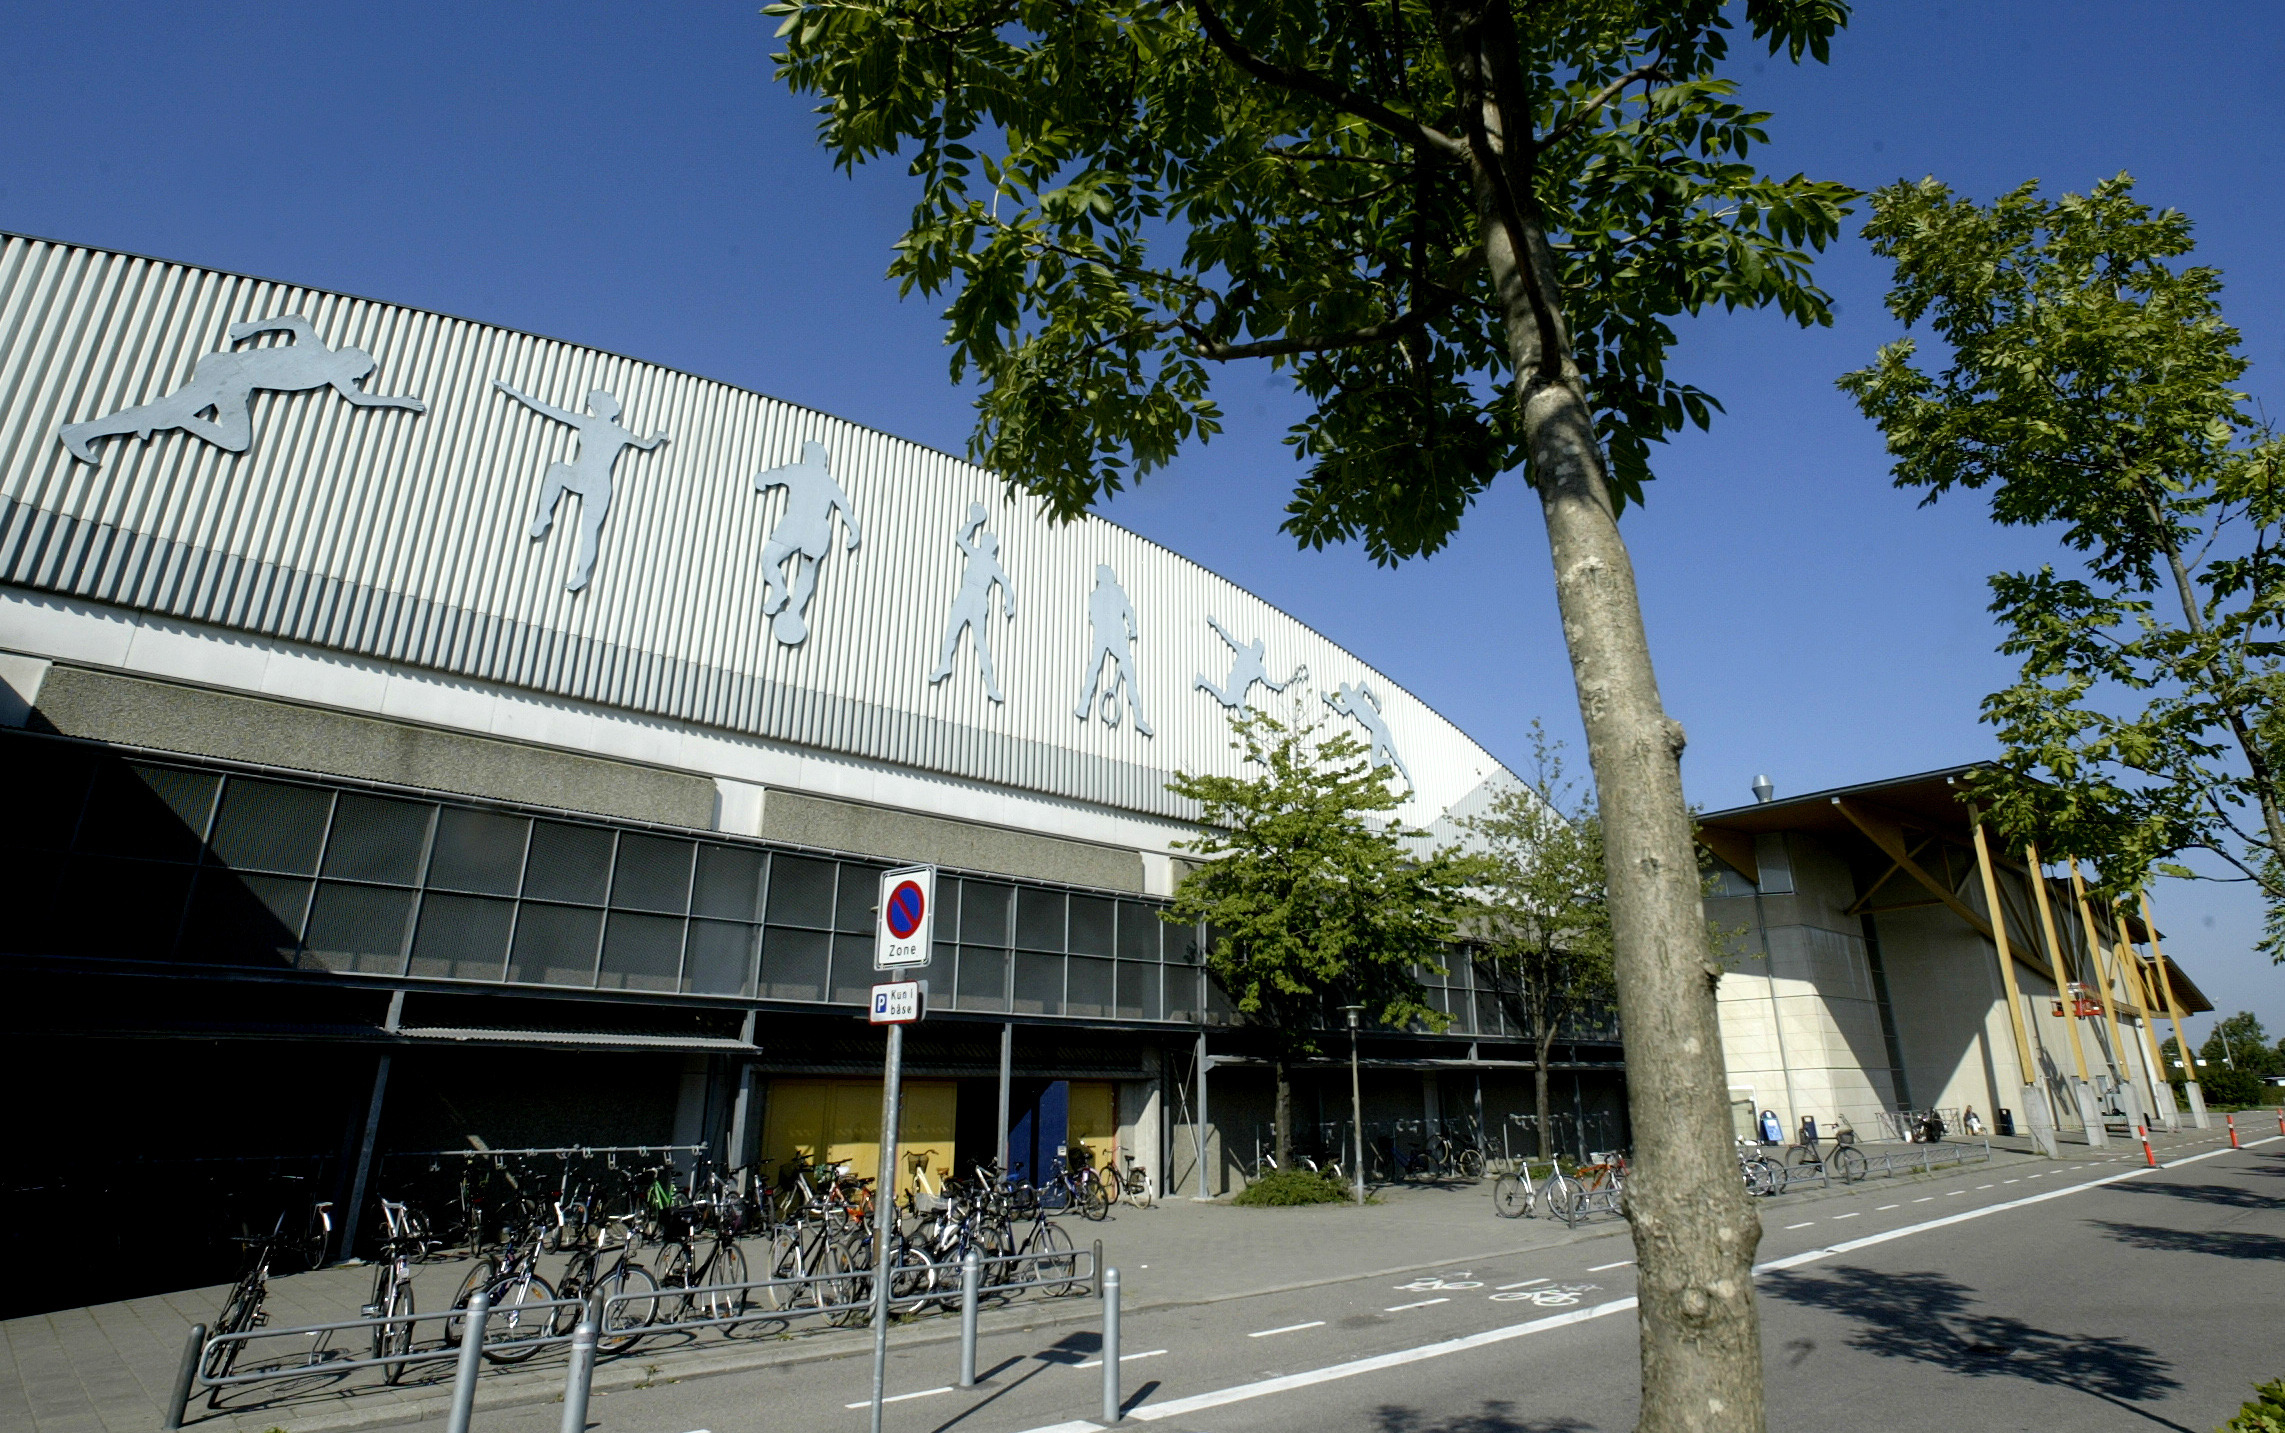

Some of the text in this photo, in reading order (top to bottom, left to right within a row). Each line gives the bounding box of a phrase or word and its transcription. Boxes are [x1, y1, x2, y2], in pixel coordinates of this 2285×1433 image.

[889, 945, 916, 956] Zone
[891, 990, 907, 1000] Kun
[891, 1004, 912, 1014] båse
